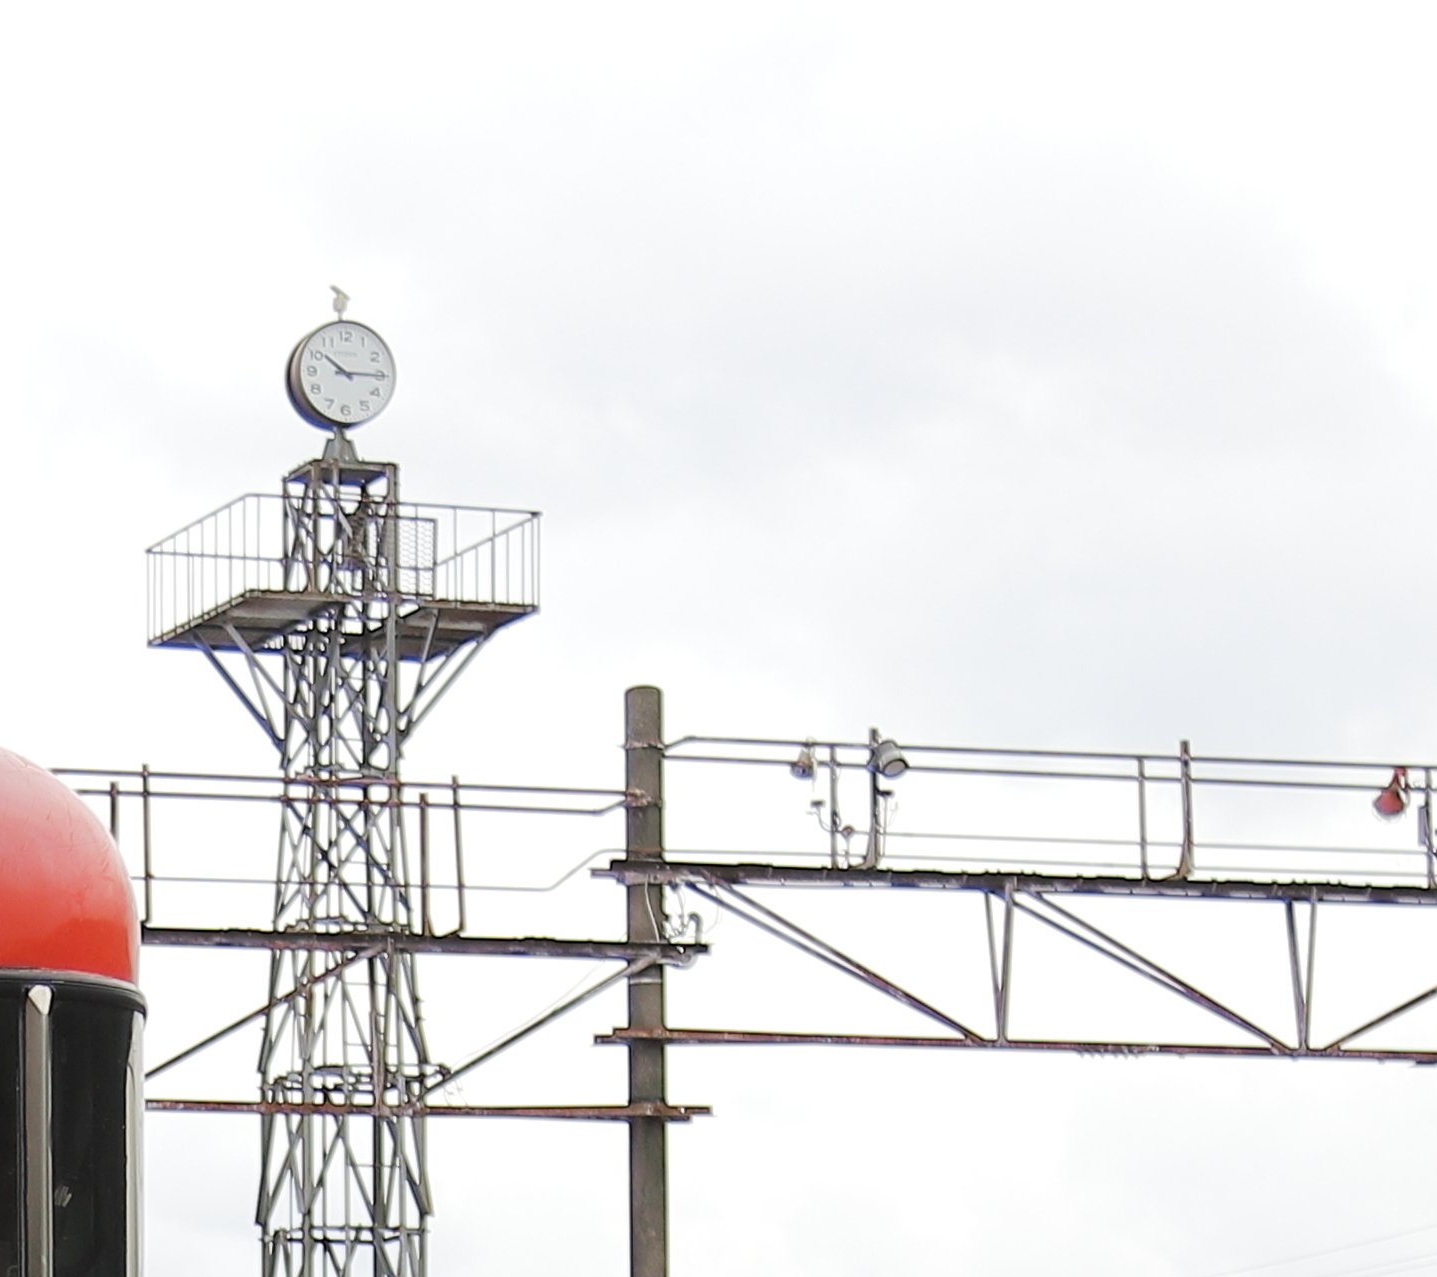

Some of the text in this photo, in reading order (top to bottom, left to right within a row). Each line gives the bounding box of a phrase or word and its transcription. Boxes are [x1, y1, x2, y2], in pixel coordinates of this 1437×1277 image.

[322, 337, 335, 348] 11
[339, 331, 353, 343] 12
[309, 350, 324, 361] 10
[370, 351, 381, 363] 2
[306, 365, 318, 377] 9
[310, 383, 322, 395] 8
[369, 387, 382, 398] 4
[324, 398, 335, 410] 7
[340, 404, 352, 416] 6
[359, 400, 371, 412] 5
